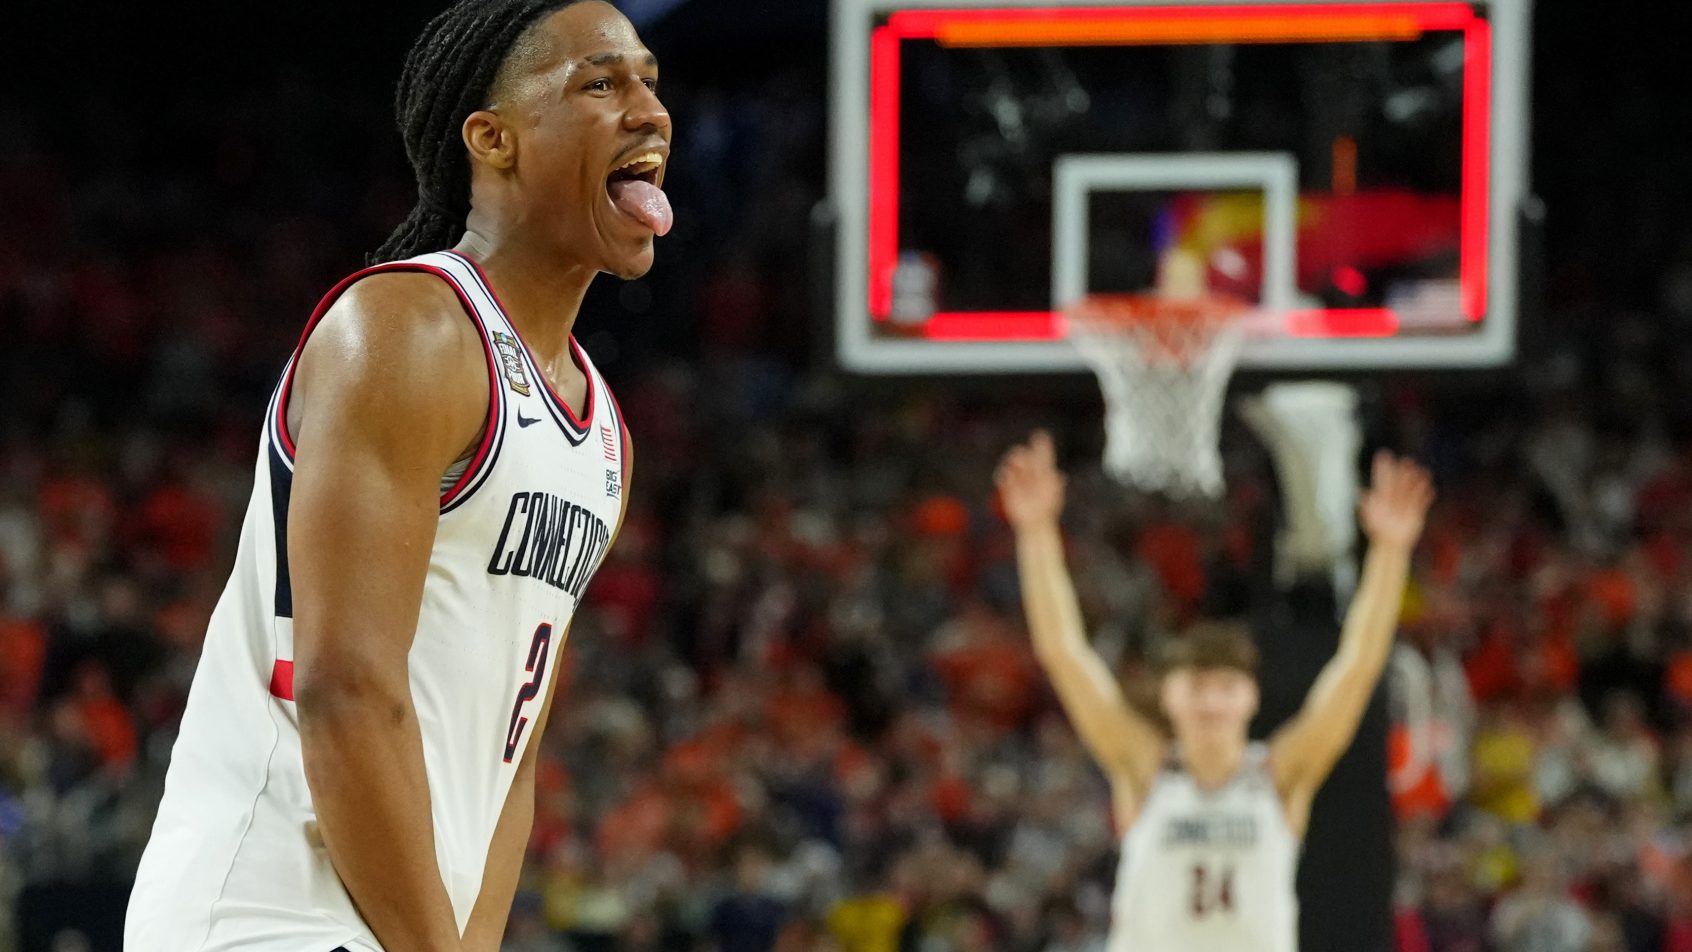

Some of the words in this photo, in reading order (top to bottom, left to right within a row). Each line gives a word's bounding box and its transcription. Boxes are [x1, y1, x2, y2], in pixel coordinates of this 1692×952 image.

[606, 469, 617, 482] BIG
[606, 481, 622, 496] EAST
[503, 622, 552, 763] 2
